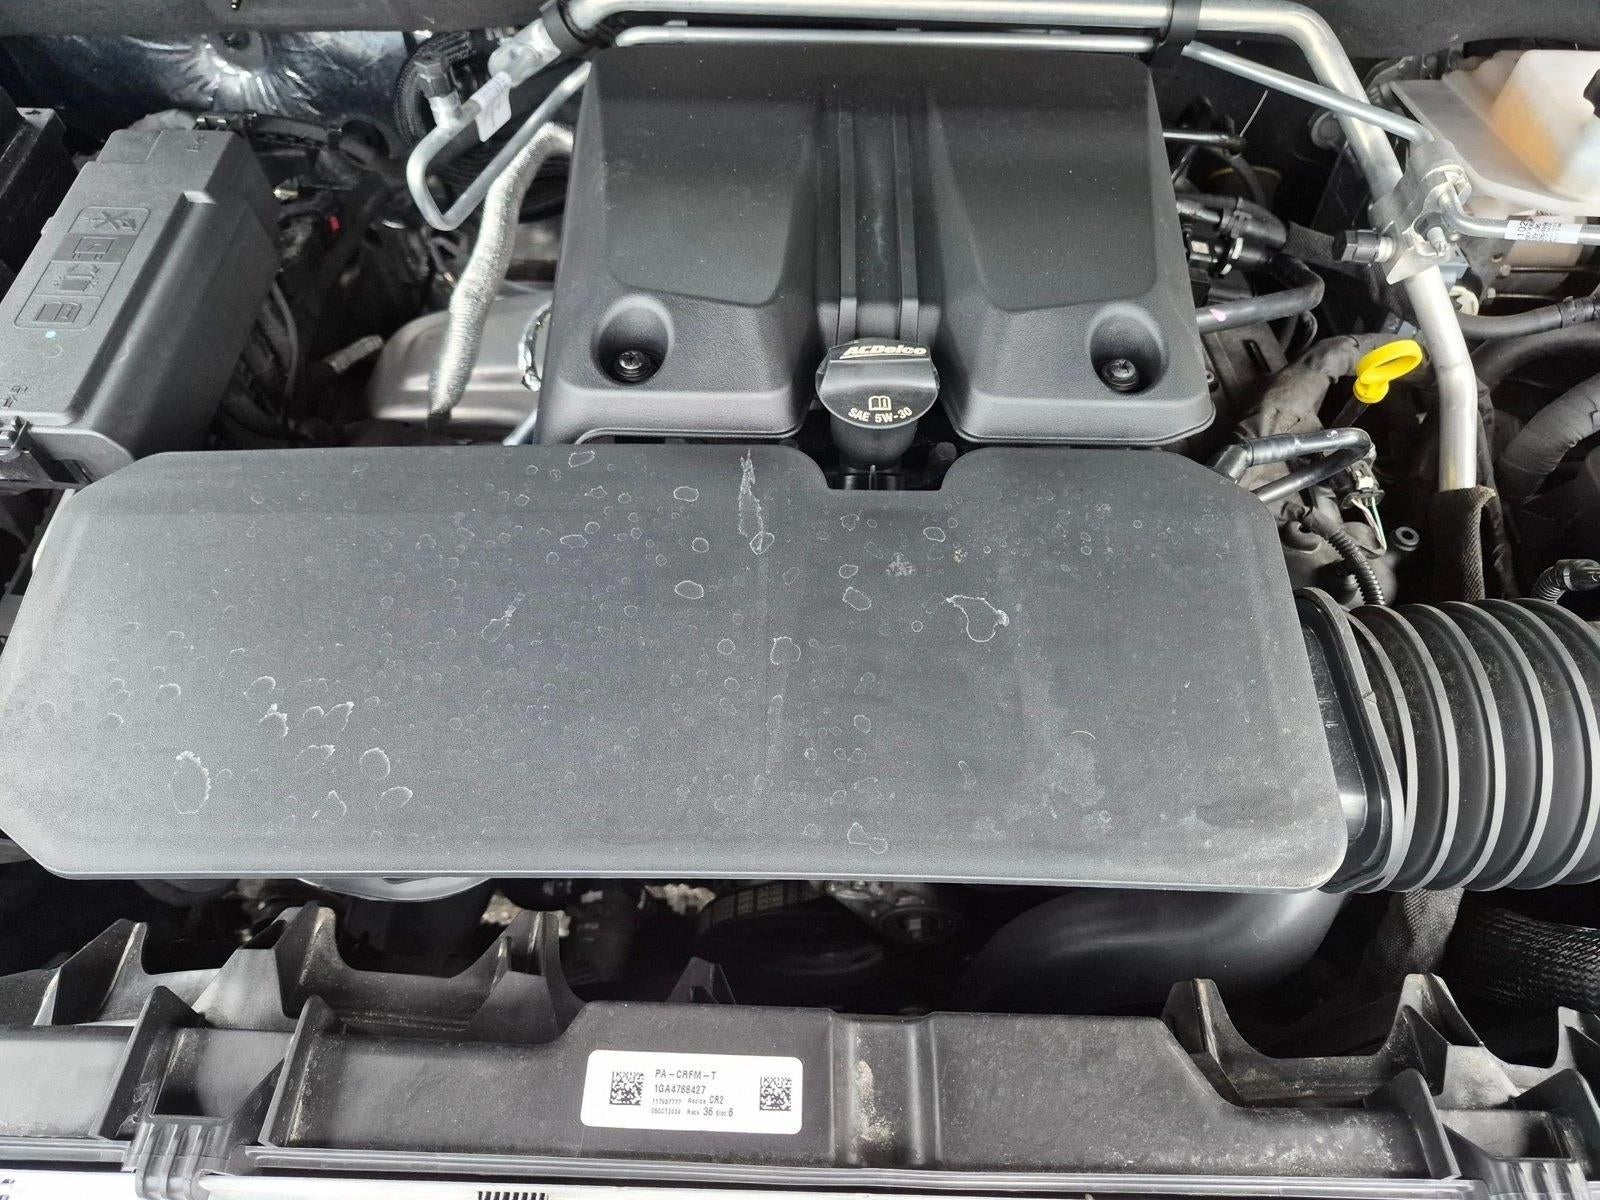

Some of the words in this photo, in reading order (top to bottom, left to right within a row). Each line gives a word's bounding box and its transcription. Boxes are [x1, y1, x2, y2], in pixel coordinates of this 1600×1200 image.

[843, 345, 927, 357] ACDelco
[848, 407, 870, 422] SAE
[874, 406, 913, 423] 5W-30
[709, 1095, 724, 1104] CR2
[728, 1107, 734, 1117] 6
